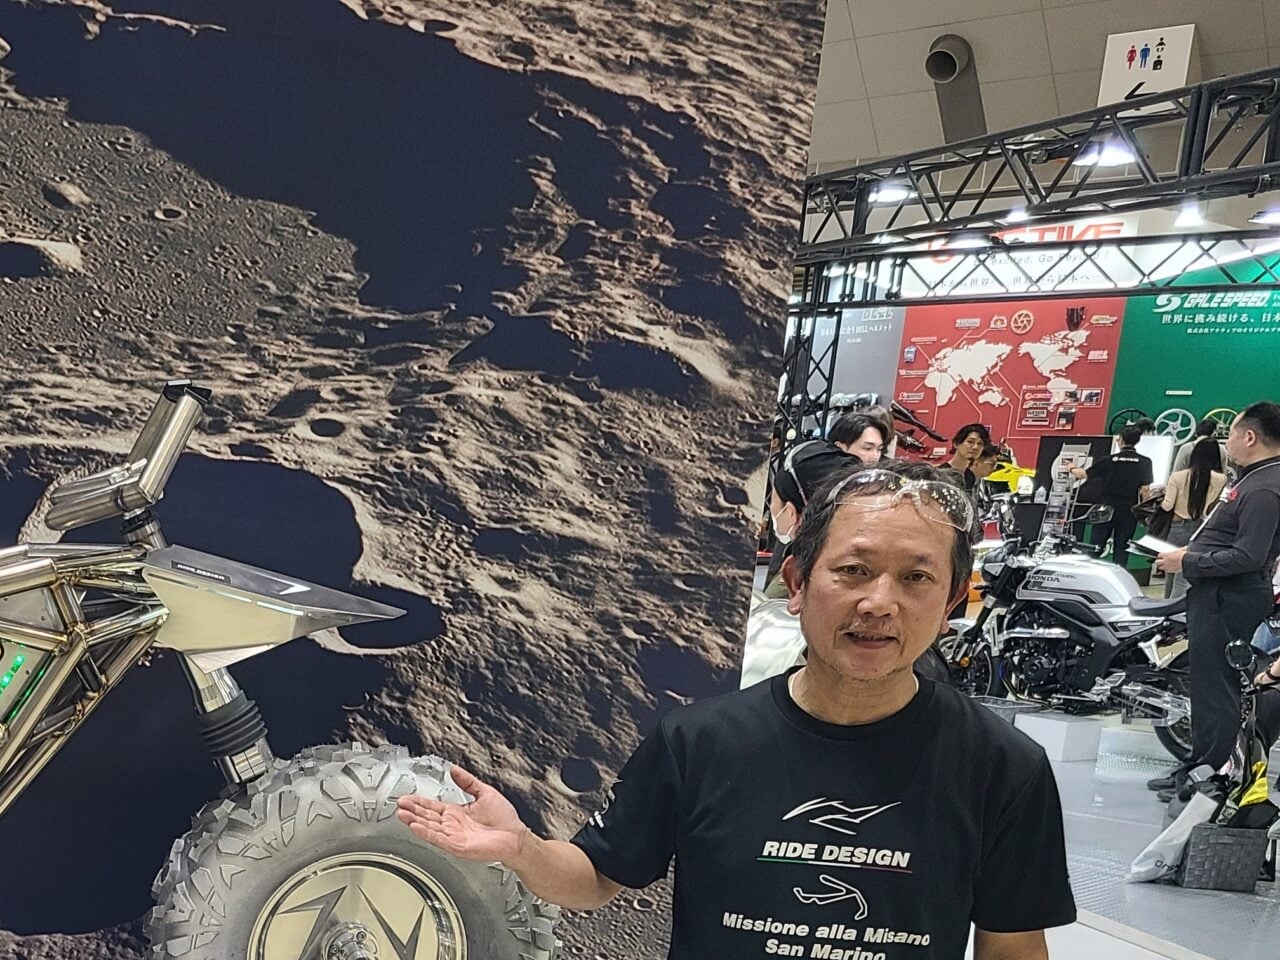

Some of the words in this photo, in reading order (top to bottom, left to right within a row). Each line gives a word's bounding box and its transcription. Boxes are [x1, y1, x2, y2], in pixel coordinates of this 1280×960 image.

[1027, 575, 1061, 583] HONDA
[762, 840, 818, 860] RIDE
[822, 845, 911, 868] DESIGN
[722, 911, 810, 937] Missione
[815, 923, 858, 942] alla
[863, 927, 931, 946] Misano
[765, 938, 804, 958] San
